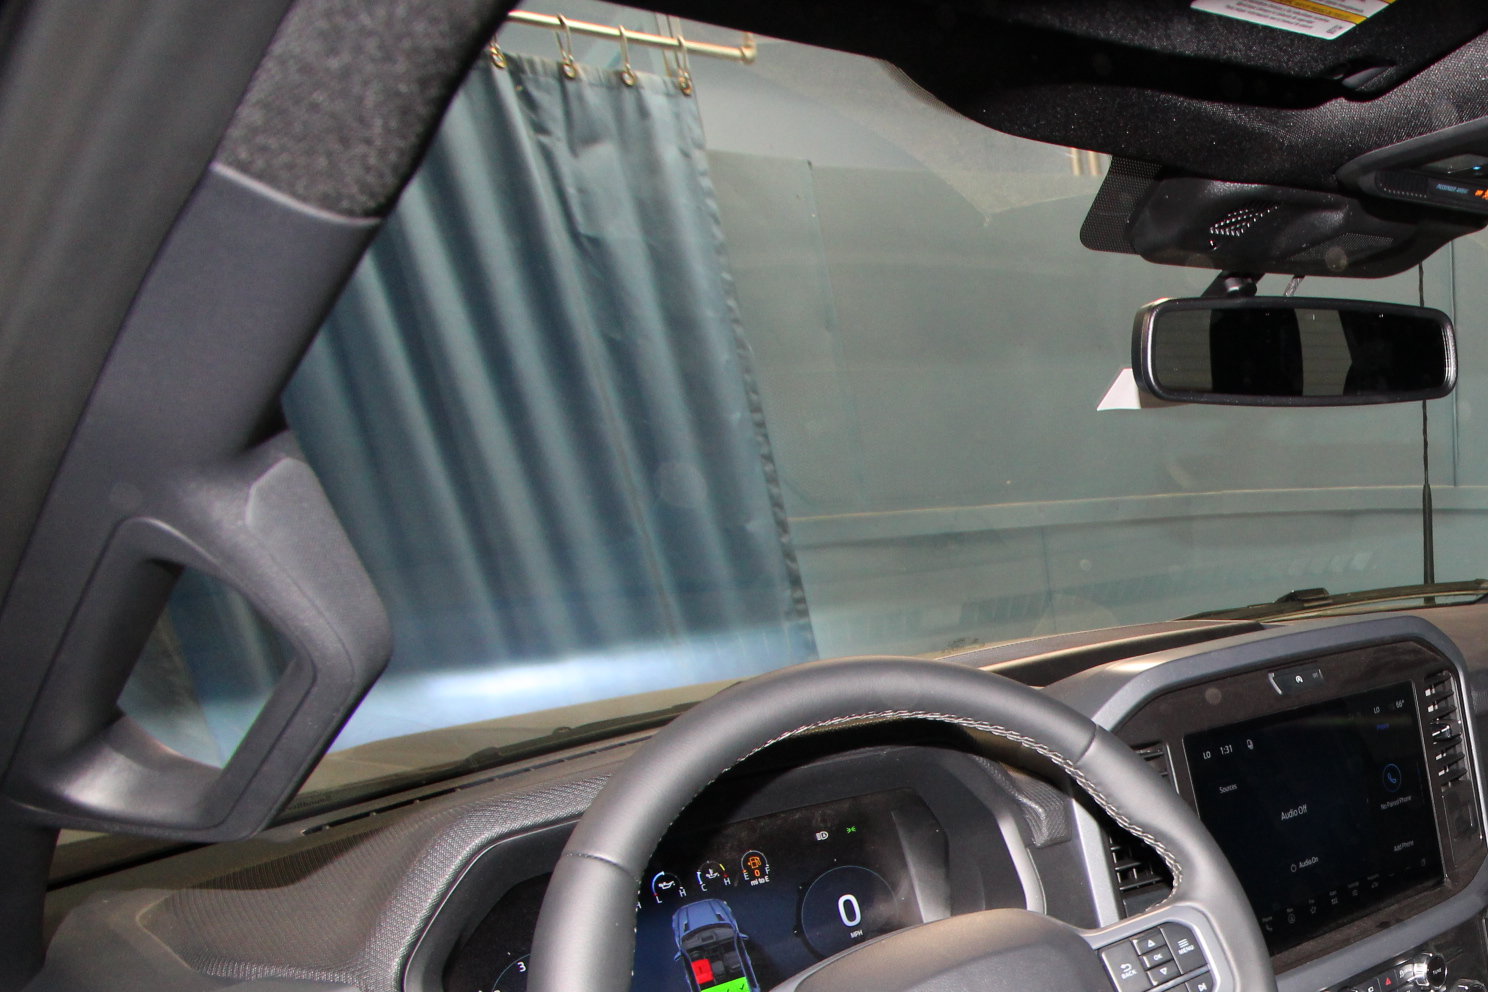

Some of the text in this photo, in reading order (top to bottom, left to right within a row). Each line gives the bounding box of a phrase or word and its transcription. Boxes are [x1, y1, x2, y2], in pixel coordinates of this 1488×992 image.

[1281, 803, 1307, 820] Audio Off
[838, 894, 861, 927] 0
[850, 929, 863, 938] MPH
[1178, 944, 1195, 955] MENU
[1153, 953, 1163, 961] OK
[517, 961, 526, 972] 3
[1120, 968, 1138, 979] BACK
